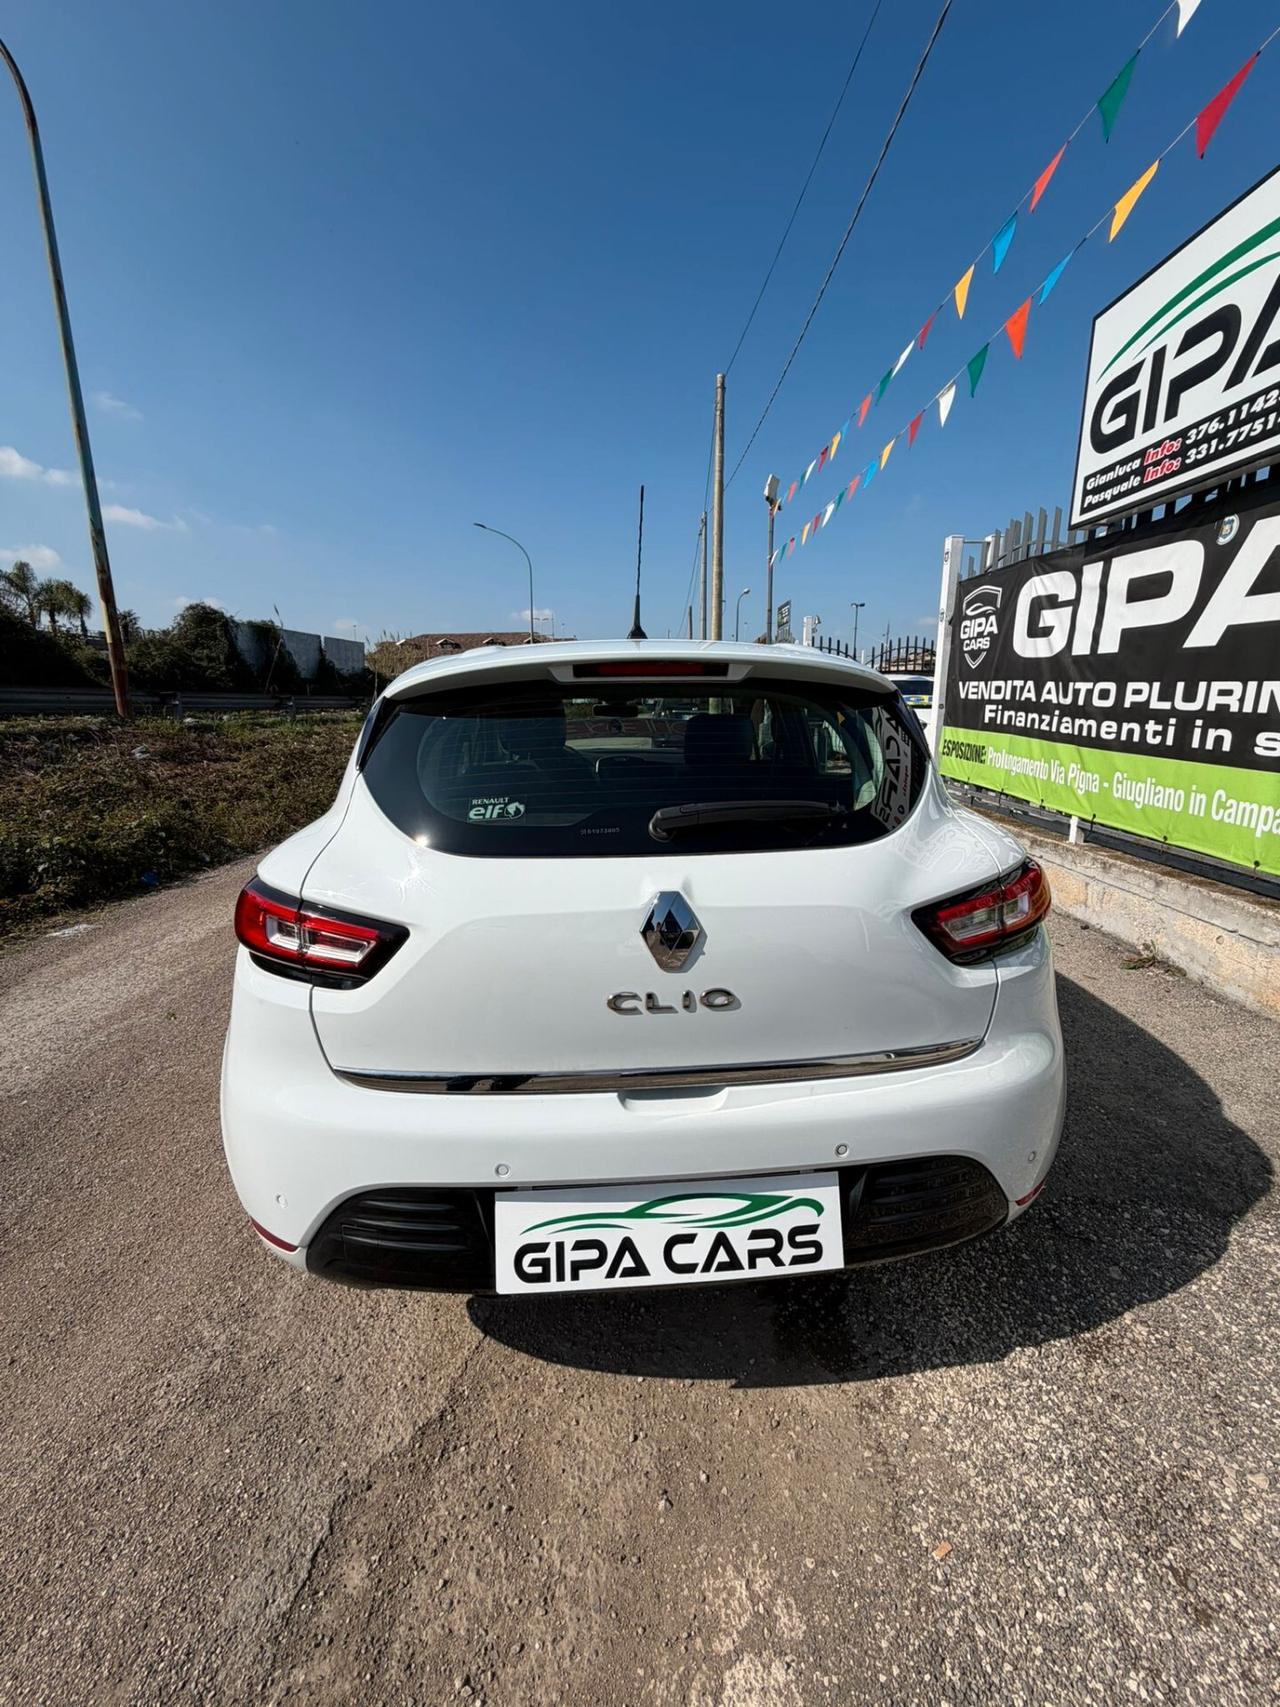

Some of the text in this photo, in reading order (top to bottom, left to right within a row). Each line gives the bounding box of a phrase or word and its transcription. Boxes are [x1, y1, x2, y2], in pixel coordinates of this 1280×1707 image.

[1086, 389, 1280, 490] Gianluca Info: 376.1142
[1083, 412, 1280, 507] Pasquale Info: 331.7751
[960, 614, 999, 639] GIPA
[963, 637, 990, 651] CARS
[958, 680, 1037, 703] VENDITA
[1041, 680, 1117, 708] AUTO
[984, 704, 1176, 747] Finanziamenti
[1191, 719, 1233, 752] in
[942, 739, 987, 764] ESPOSIZIONE:
[987, 746, 1049, 780] Prolungamento
[1051, 759, 1065, 785] Via
[1066, 763, 1099, 794] Pigna
[1113, 771, 1185, 813] Giugliano
[1188, 785, 1207, 817] in
[468, 805, 502, 819] elf
[472, 797, 509, 805] RENAULT
[606, 987, 741, 1014] CLIO
[513, 1224, 824, 1284] GIPA CARS
